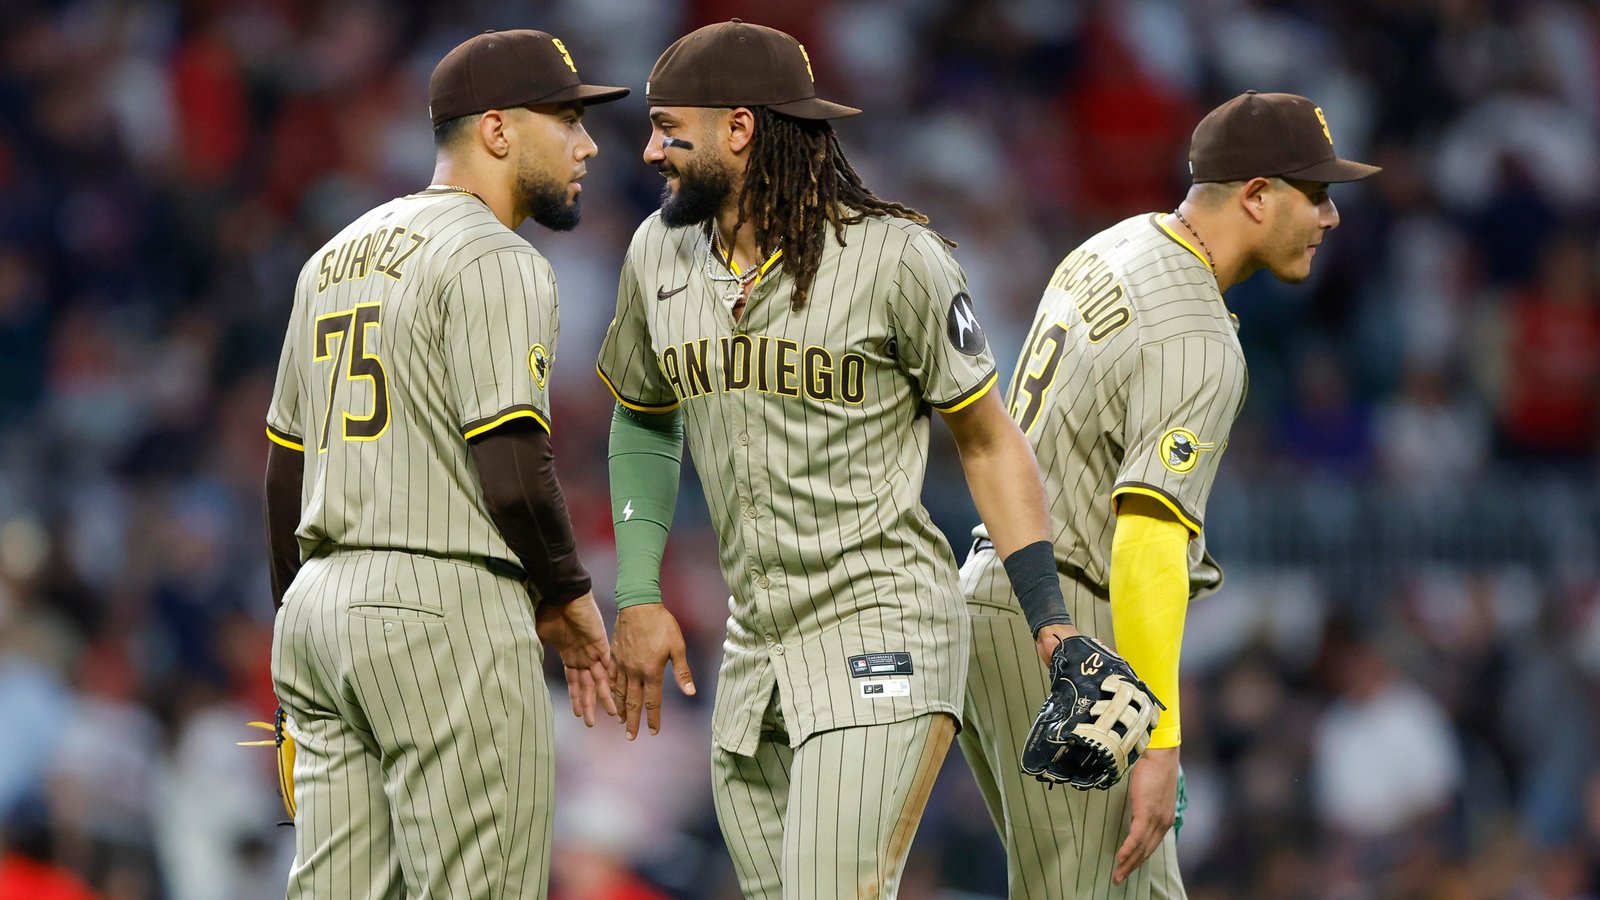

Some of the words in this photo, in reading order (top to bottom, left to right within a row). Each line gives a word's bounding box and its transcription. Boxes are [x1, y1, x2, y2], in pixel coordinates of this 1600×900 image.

[318, 224, 426, 293] SUAREZ
[1049, 247, 1131, 344] ACHADO
[313, 301, 391, 453] 75
[656, 337, 715, 402] AN
[719, 334, 866, 404] DIEGO
[1080, 652, 1104, 676] 23
